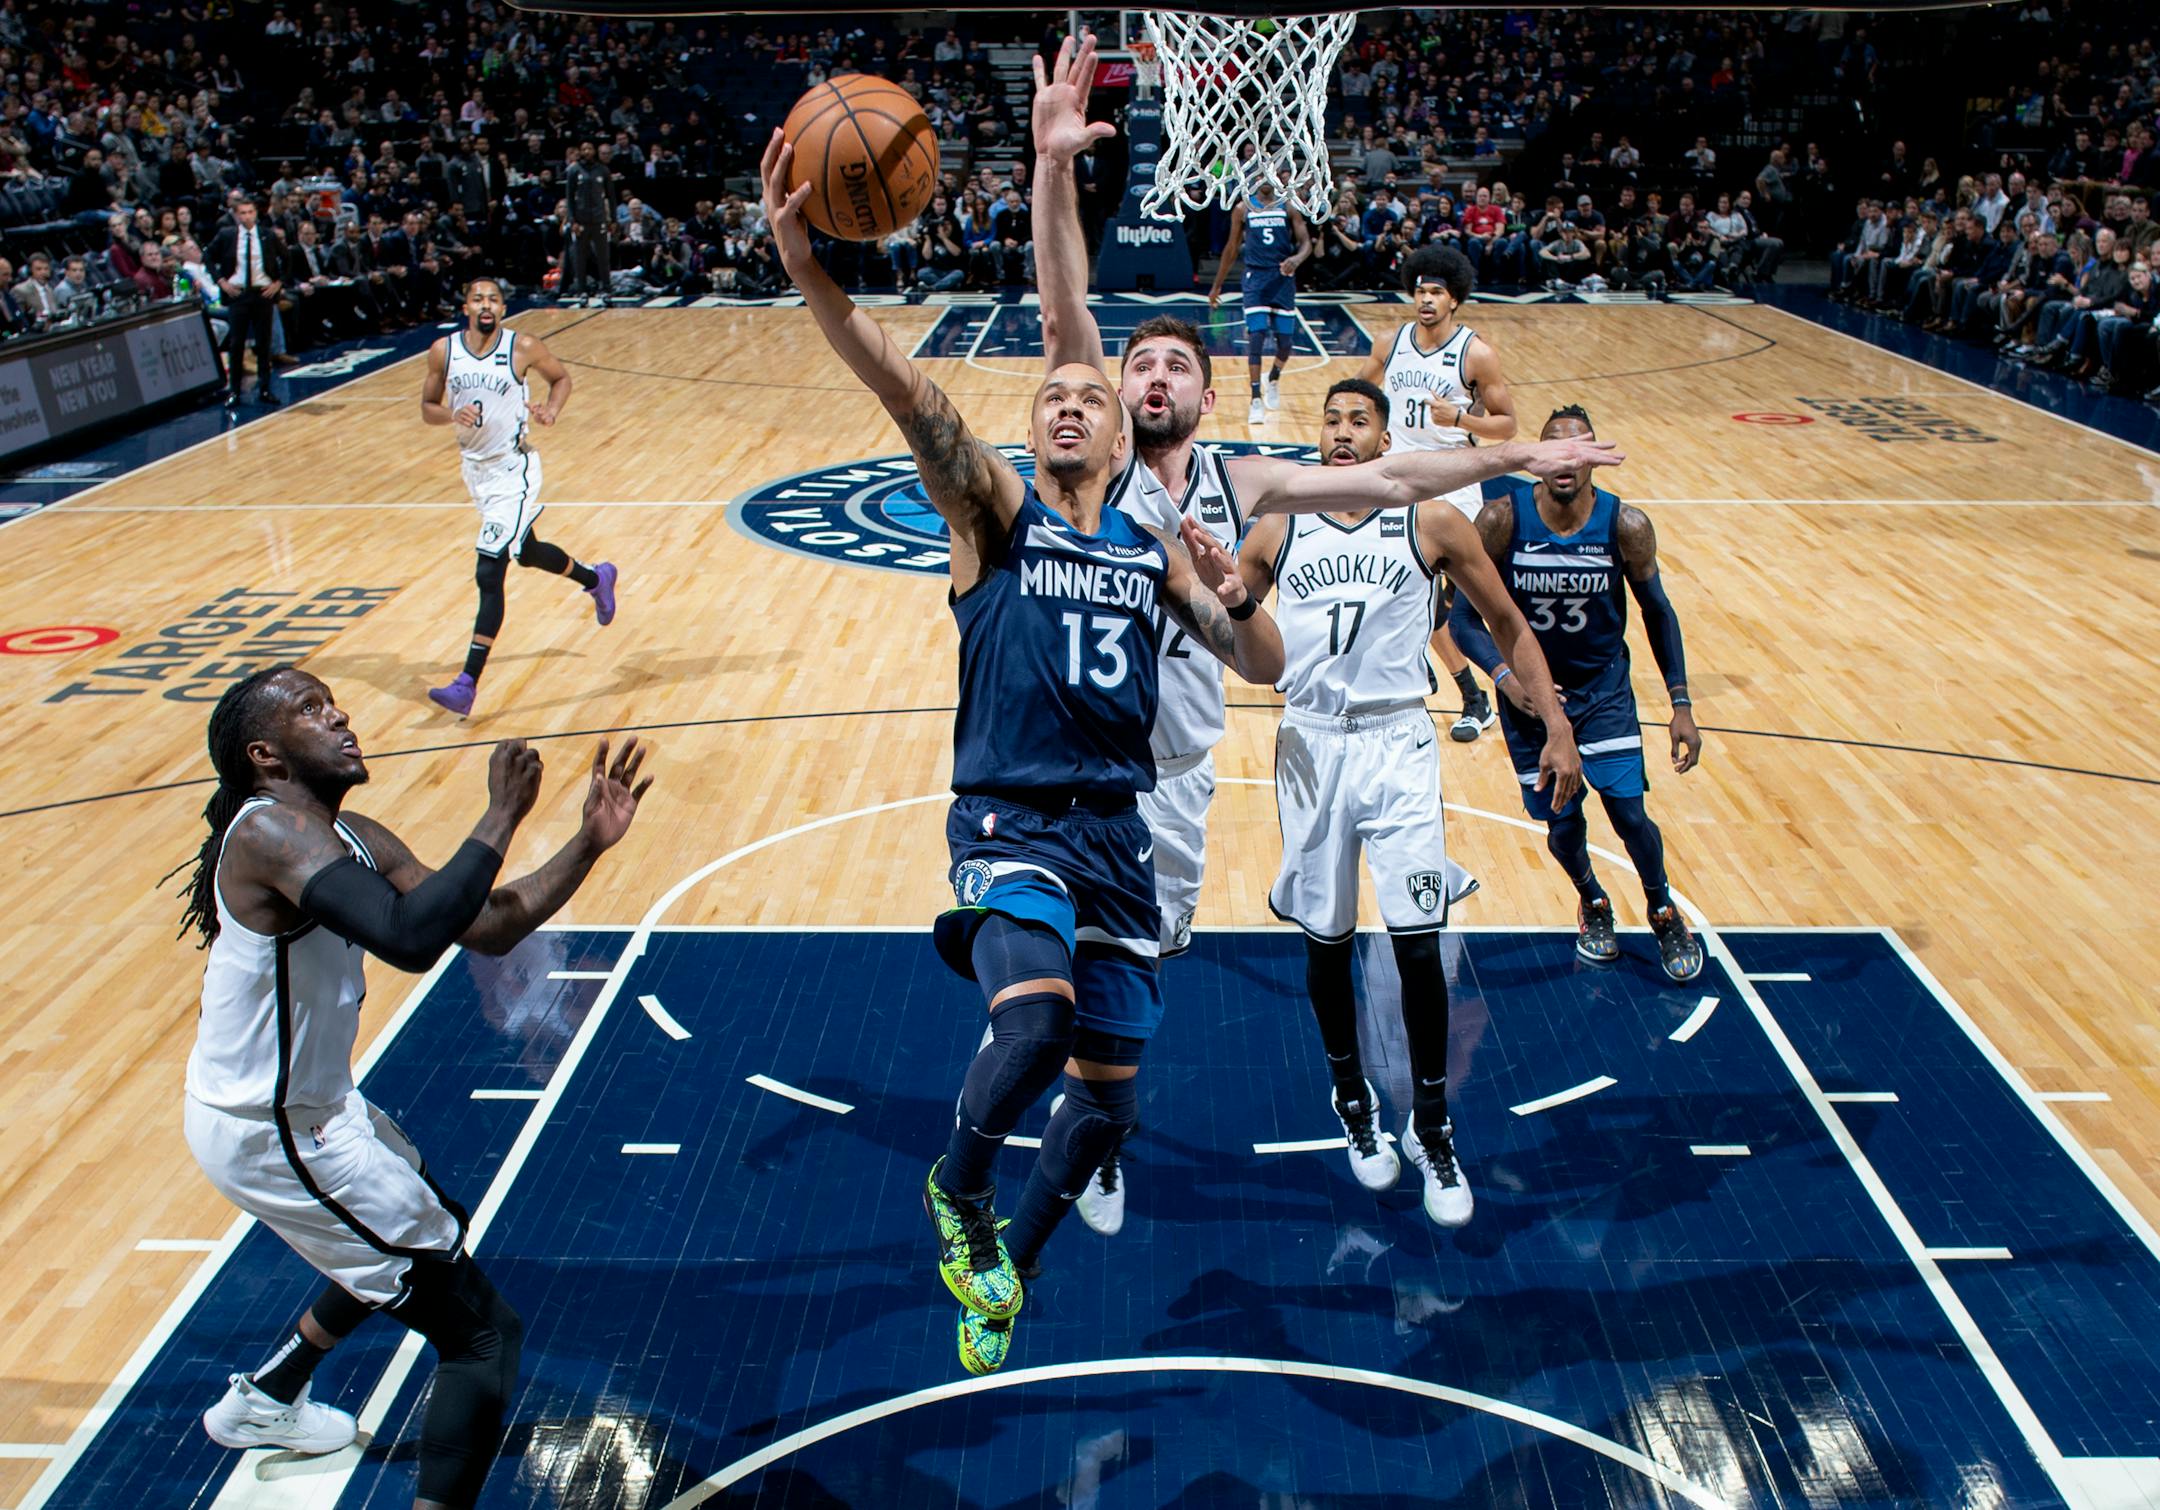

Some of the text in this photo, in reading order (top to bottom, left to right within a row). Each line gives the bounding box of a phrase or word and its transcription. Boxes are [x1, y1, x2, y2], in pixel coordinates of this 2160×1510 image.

[1116, 226, 1173, 247] HyVee
[1262, 227, 1275, 245] 5
[49, 360, 81, 389] NEW
[82, 352, 117, 382] YEAR
[159, 333, 208, 378] fitbit
[56, 378, 118, 416] NEW YOU
[450, 372, 511, 396] BROOKLYN
[1389, 370, 1453, 398] BROOKLYN
[1405, 398, 1426, 429] 31
[1795, 397, 1928, 442] TARGET
[1858, 397, 1999, 443] CENTER
[1381, 522, 1404, 531] infor
[1115, 546, 1145, 557] fitbit
[1585, 545, 1605, 554] fitbit
[1020, 559, 1156, 616] MINNESOTA
[1287, 554, 1412, 600] BROOKLYN
[1513, 570, 1609, 594] MINNESOTA
[1326, 601, 1366, 656] 17
[1529, 597, 1590, 633] 33
[42, 587, 299, 704] TARGET
[162, 586, 401, 703] CENTER
[1062, 612, 1131, 688] 13
[1410, 873, 1441, 893] NETS
